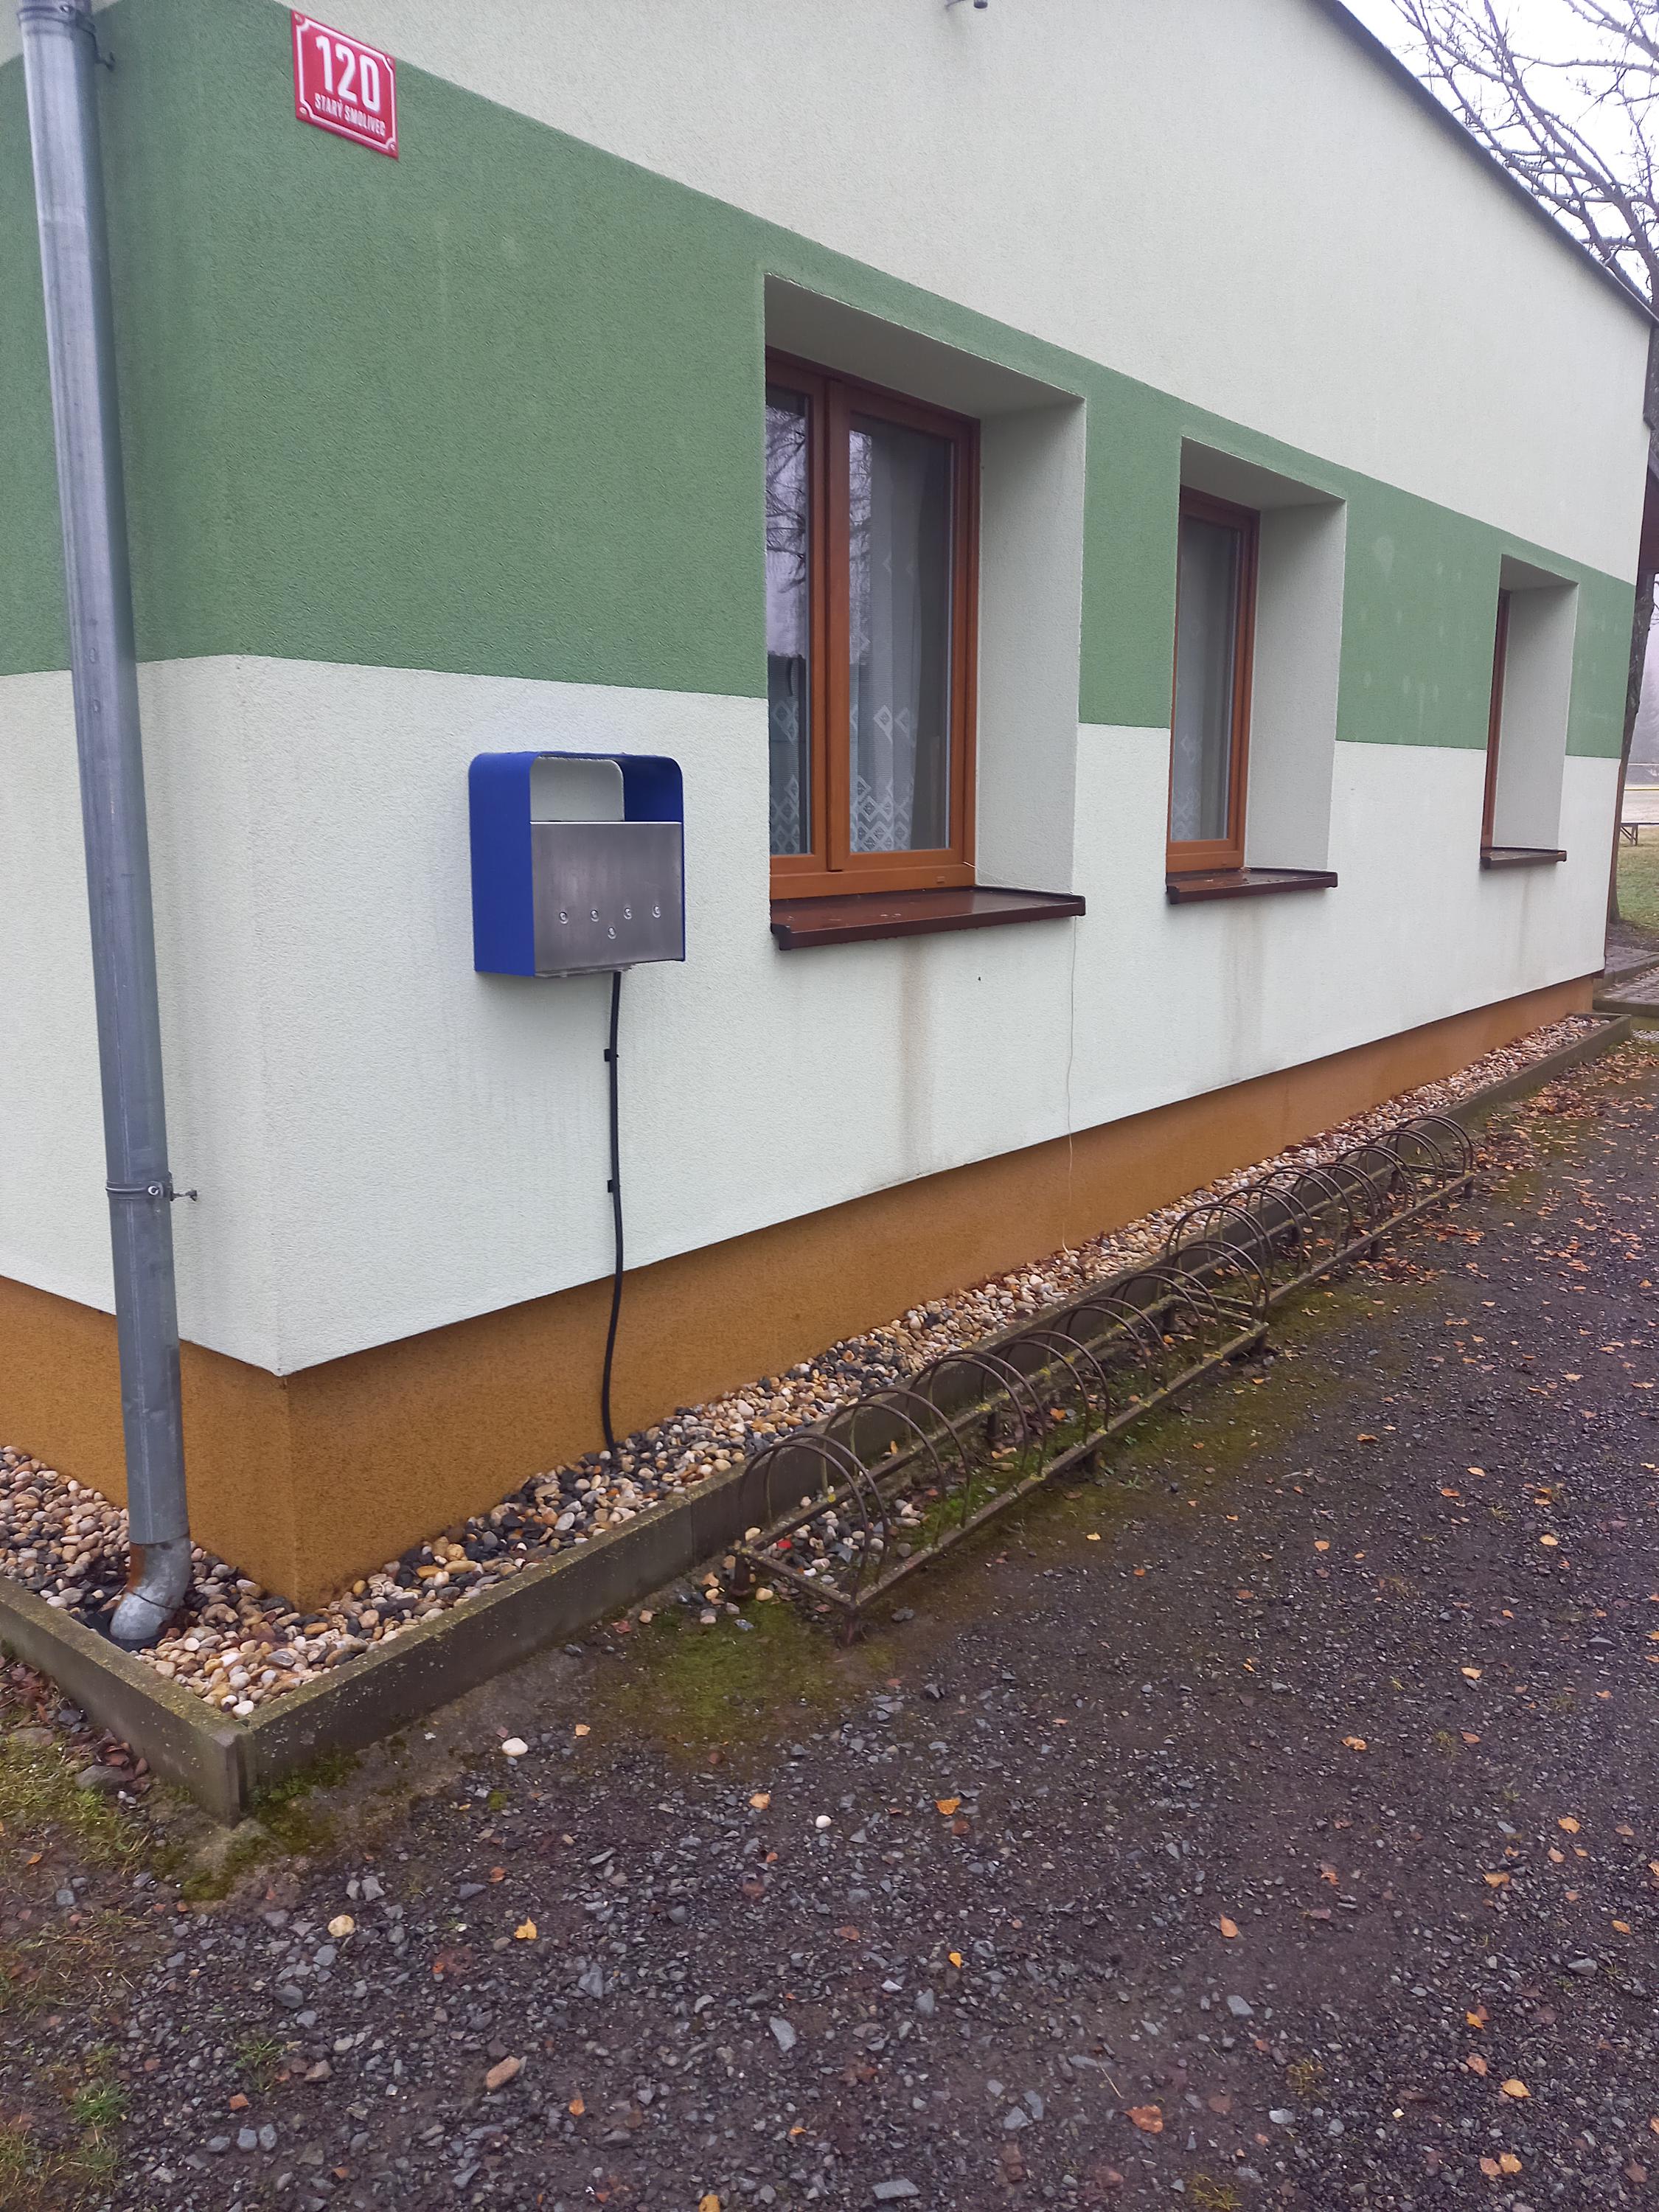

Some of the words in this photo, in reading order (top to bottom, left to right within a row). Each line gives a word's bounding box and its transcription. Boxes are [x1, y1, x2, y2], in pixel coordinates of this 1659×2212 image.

[315, 35, 380, 113] 120
[315, 93, 343, 119] STARÝ
[344, 105, 386, 136] SMOLIVEC
